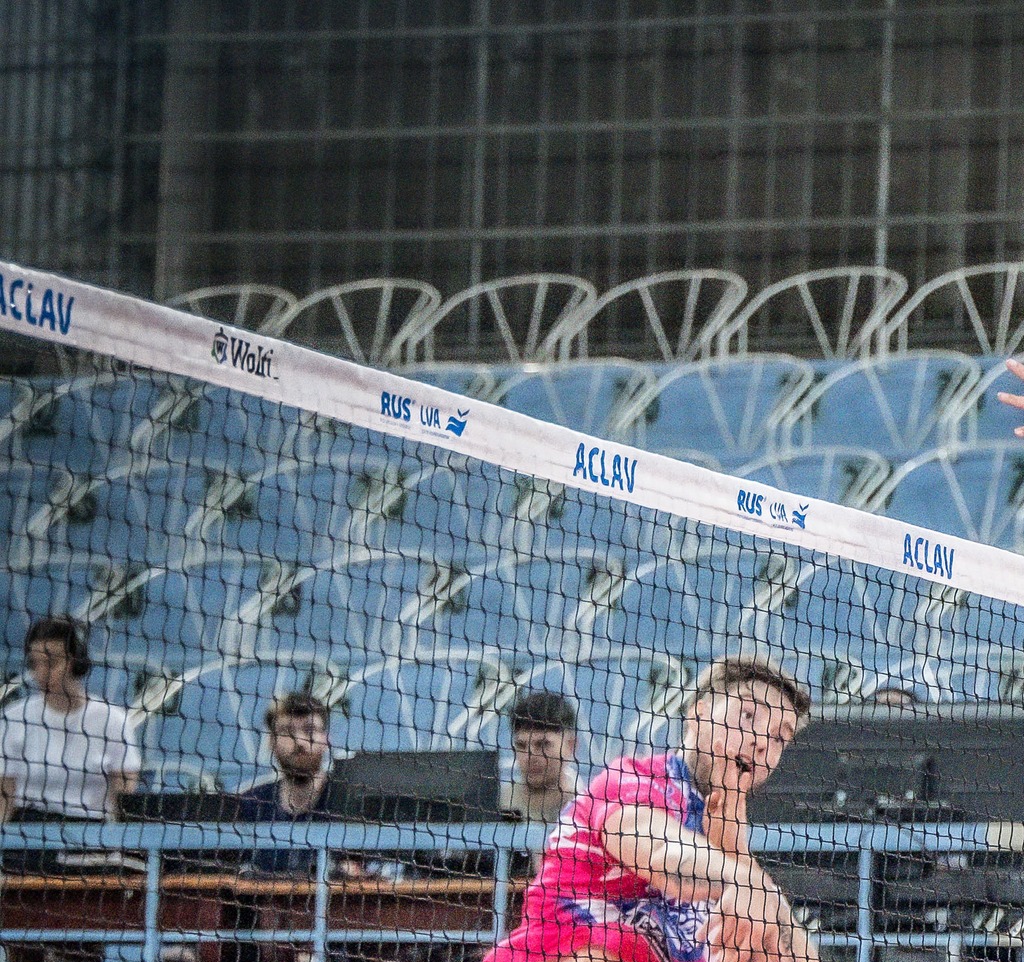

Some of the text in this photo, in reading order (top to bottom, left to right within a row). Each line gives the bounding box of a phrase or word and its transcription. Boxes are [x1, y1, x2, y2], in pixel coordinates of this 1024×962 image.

[381, 391, 411, 422] RUS
[421, 405, 441, 429] LVA
[573, 442, 638, 494] ACLAV
[737, 489, 763, 516] RUS
[903, 533, 956, 580] ACLAV
